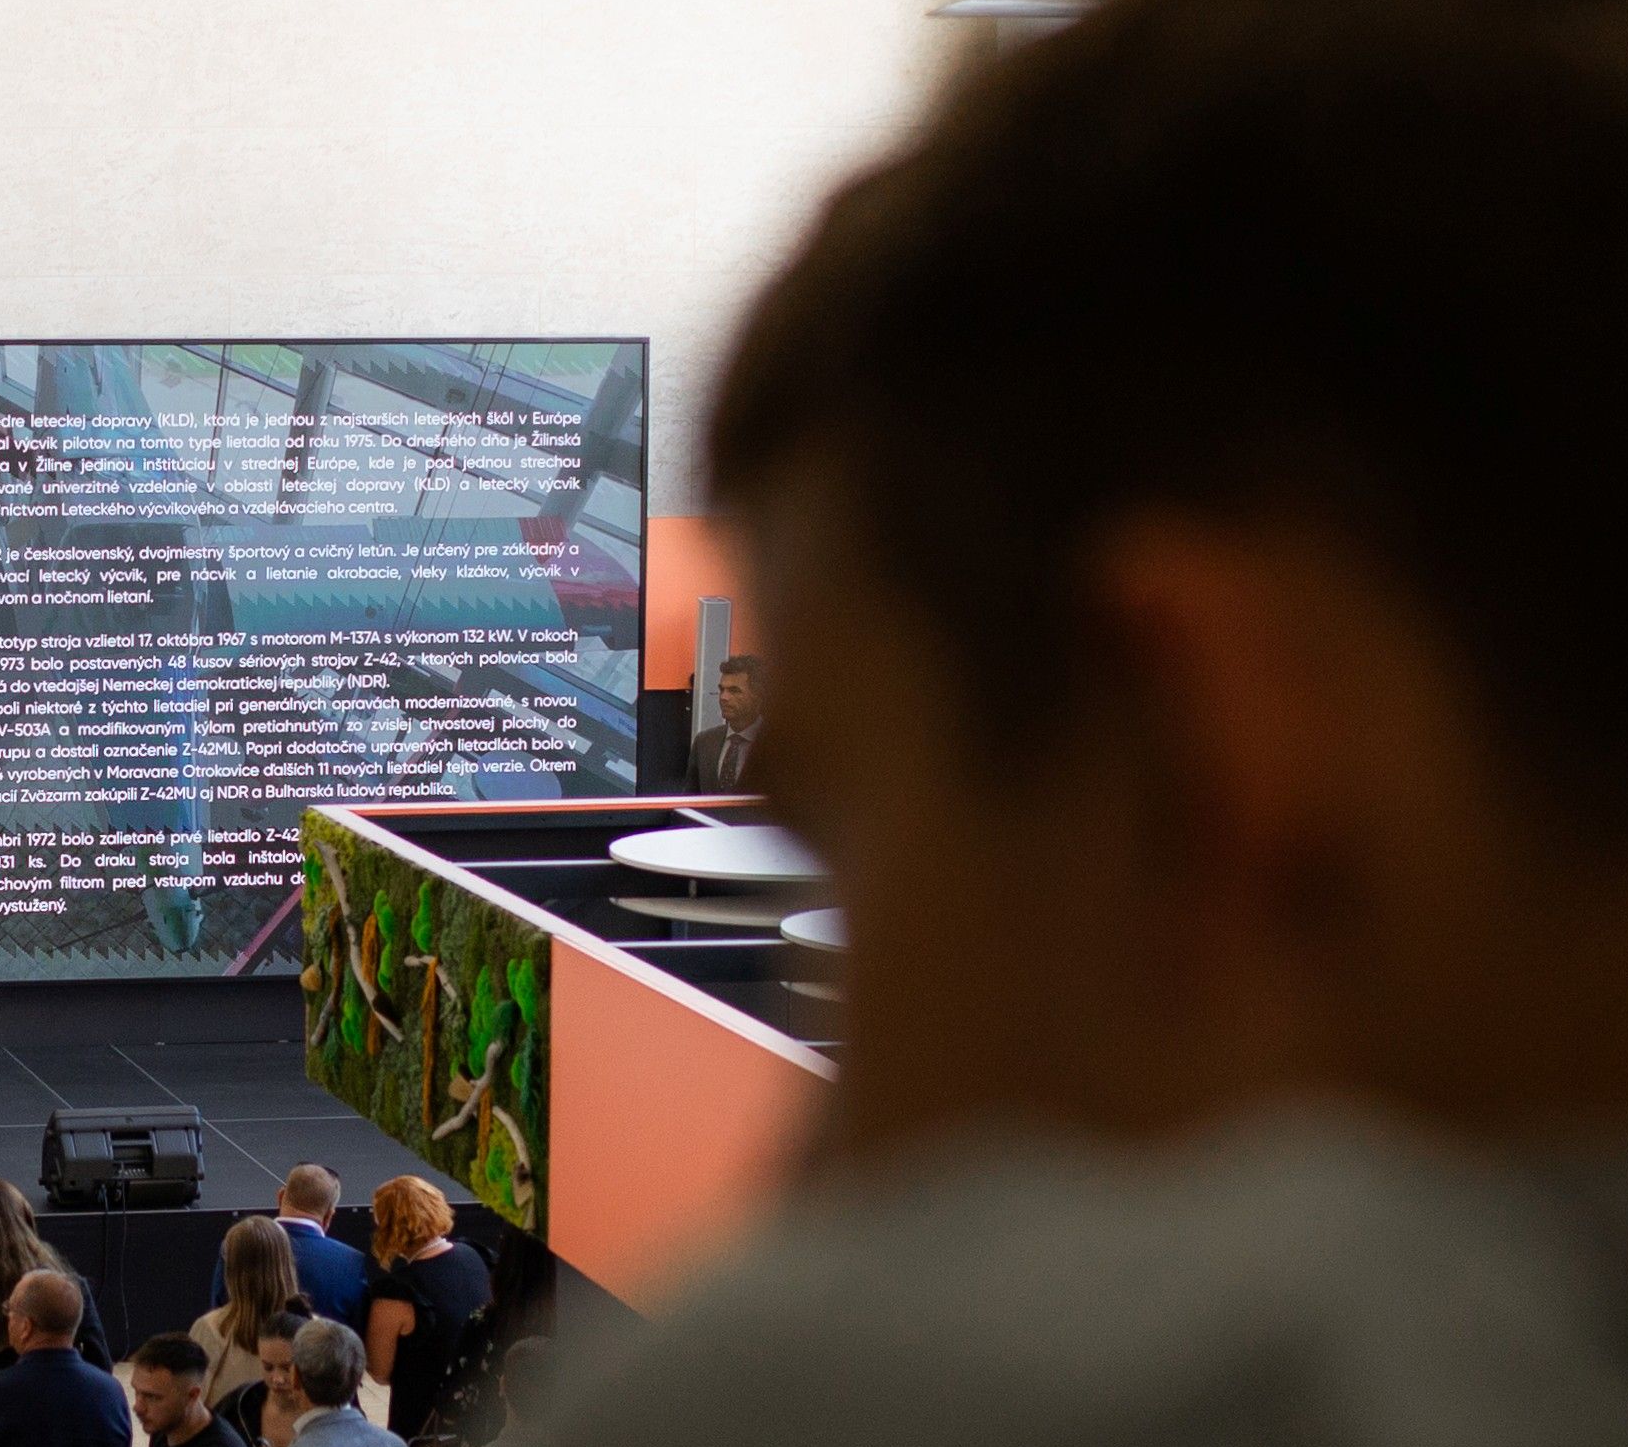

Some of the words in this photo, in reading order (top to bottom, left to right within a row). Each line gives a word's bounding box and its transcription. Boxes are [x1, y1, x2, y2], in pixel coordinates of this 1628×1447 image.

[30, 413, 85, 430] leteckej
[91, 414, 152, 429] dopravy
[158, 412, 197, 429] (KLD),
[204, 413, 240, 426] ktorá
[264, 413, 314, 428] jednou
[414, 411, 481, 427] leteckých
[532, 411, 581, 427] Európe
[13, 436, 58, 453] výcvik
[62, 435, 111, 452] pilotov
[140, 435, 183, 448] tomto
[227, 435, 279, 447] lietadla
[344, 434, 375, 446] 1975.
[406, 434, 476, 446] dnešného
[531, 430, 581, 446] Žilinská
[79, 457, 134, 474] jedinou
[242, 456, 298, 472] strednej
[307, 456, 359, 471] Európe,
[461, 455, 511, 471] jednou
[521, 454, 580, 468] strechou
[42, 480, 119, 493] univerzitné
[128, 478, 197, 492] vzdelanie
[224, 479, 272, 492] oblasti
[282, 478, 336, 494] leteckej
[345, 478, 405, 493] dopravy
[414, 476, 450, 493] (KLD)
[479, 476, 529, 492] letecký
[537, 476, 580, 492] výcvik
[62, 502, 135, 515] Leteckého
[138, 502, 225, 518] výcvikového
[242, 501, 344, 514] vzdelávacieho
[348, 500, 397, 514] centra.
[23, 546, 134, 562] československý,
[138, 545, 224, 562] dvojmiestny
[228, 545, 290, 560] športový
[309, 544, 354, 560] cvičný
[358, 543, 396, 556] letún.
[423, 543, 470, 558] určený
[502, 541, 565, 558] základný
[39, 568, 91, 584] letecký
[99, 567, 147, 584] výcvik,
[190, 567, 236, 580] nácvik
[266, 566, 317, 579] lietanie
[326, 566, 401, 580] akrobacie,
[410, 565, 447, 580] vleky
[456, 564, 509, 578] klzákov,
[518, 564, 561, 579] výcvik
[45, 590, 104, 603] nočnom
[107, 589, 153, 603] lietaní.
[41, 634, 81, 651] stroja
[84, 633, 134, 647] vzlietol
[156, 633, 213, 646] októbra
[261, 631, 326, 645] motorom
[330, 630, 381, 644] M-137A
[395, 630, 459, 646] výkonom
[531, 628, 578, 641] rokoch
[69, 655, 162, 672] postavených
[192, 654, 233, 668] kusov
[311, 653, 358, 669] strojov
[364, 652, 401, 667] Z-42,
[421, 652, 473, 668] ktorých
[479, 651, 539, 667] polovica
[33, 678, 99, 695] vtedajšej
[102, 677, 173, 693] Nemeckej
[178, 676, 277, 693] demokratickej
[281, 675, 344, 692] republiky
[347, 675, 390, 691] (NDR).
[25, 700, 82, 714] niektoré
[101, 699, 148, 716] týchto
[154, 699, 209, 712] lietadiel
[238, 697, 326, 713] generálnych
[331, 696, 400, 712] opravách
[402, 694, 515, 709] modernizované,
[534, 696, 576, 706] novou
[77, 721, 185, 737] modifikovaným
[193, 720, 235, 736] kýlom
[243, 719, 338, 735] pretiahnutým
[371, 717, 415, 733] zvislej
[419, 716, 495, 732] chvostovej
[502, 715, 549, 731] plochy
[50, 744, 98, 757] dostali
[103, 743, 177, 756] označenie
[182, 742, 240, 755] Z-42MU.
[245, 741, 282, 757] Popri
[286, 740, 366, 753] dodatočne
[371, 739, 453, 754] upravených
[458, 737, 527, 751] lietadlách
[6, 766, 90, 783] vyrobených
[106, 764, 178, 778] Moravane
[182, 763, 259, 777] Otrokovice
[332, 761, 383, 777] nových
[387, 761, 442, 774] lietadiel
[446, 760, 478, 775] tejto
[482, 759, 525, 773] verzie.
[529, 758, 576, 771] Okrem
[20, 788, 81, 801] Zväzarm
[84, 787, 137, 803] zakúpili
[140, 786, 196, 799] Z-42MU
[265, 783, 333, 797] Bulharská
[337, 783, 385, 796] ľudová
[388, 782, 456, 798] republika.
[99, 830, 164, 844] zalietané
[208, 829, 261, 842] lietadlo
[94, 853, 135, 866] draku
[149, 852, 188, 868] stroja
[248, 850, 305, 863] inštalov
[59, 876, 104, 888] filtrom
[153, 873, 215, 889] vstupom
[222, 871, 283, 885] vzduchu
